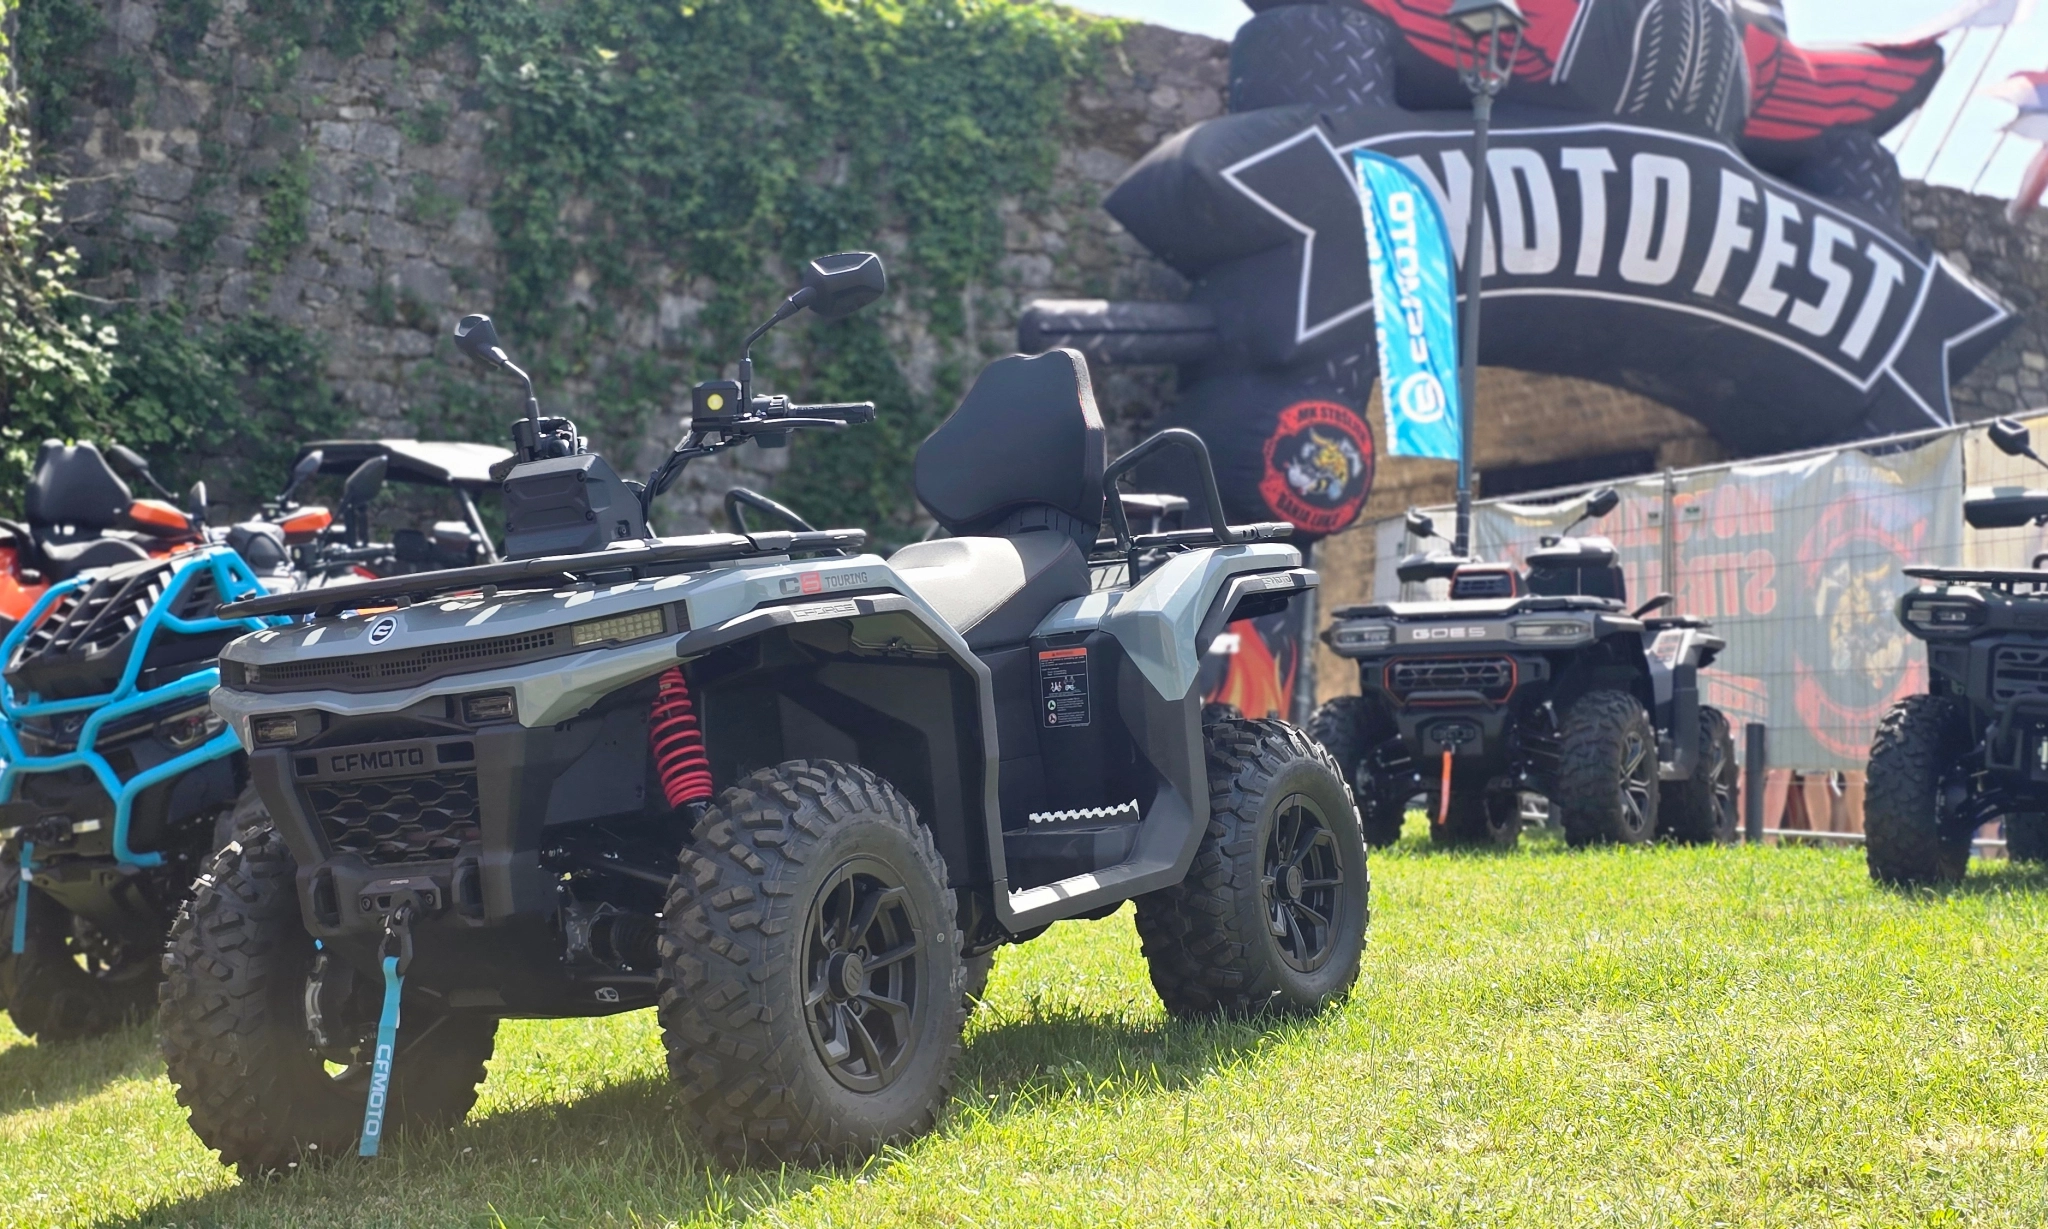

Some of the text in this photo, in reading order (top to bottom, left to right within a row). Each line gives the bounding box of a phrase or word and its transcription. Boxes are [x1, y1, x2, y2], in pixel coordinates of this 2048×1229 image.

[1692, 167, 1906, 361] FEST
[825, 572, 868, 588] TOURING
[1412, 626, 1486, 640] GOES
[331, 748, 424, 773] CFMOTO
[365, 1044, 392, 1136] CFMOTO
